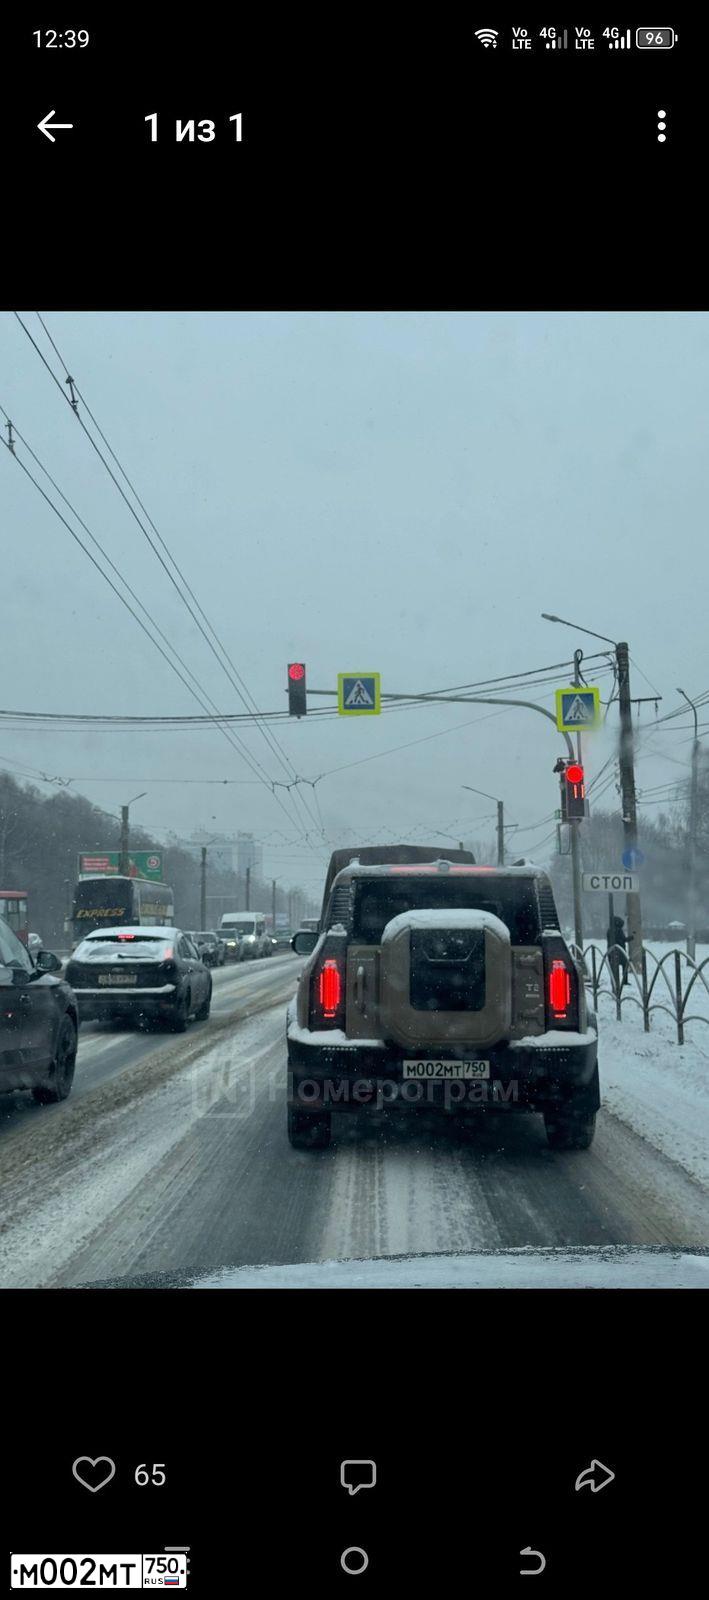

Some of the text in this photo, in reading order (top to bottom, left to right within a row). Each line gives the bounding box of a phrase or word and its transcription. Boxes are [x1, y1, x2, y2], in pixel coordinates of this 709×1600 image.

[590, 876, 633, 890] СТОП
[76, 907, 126, 919] EXPRESS
[465, 1061, 487, 1073] 750
